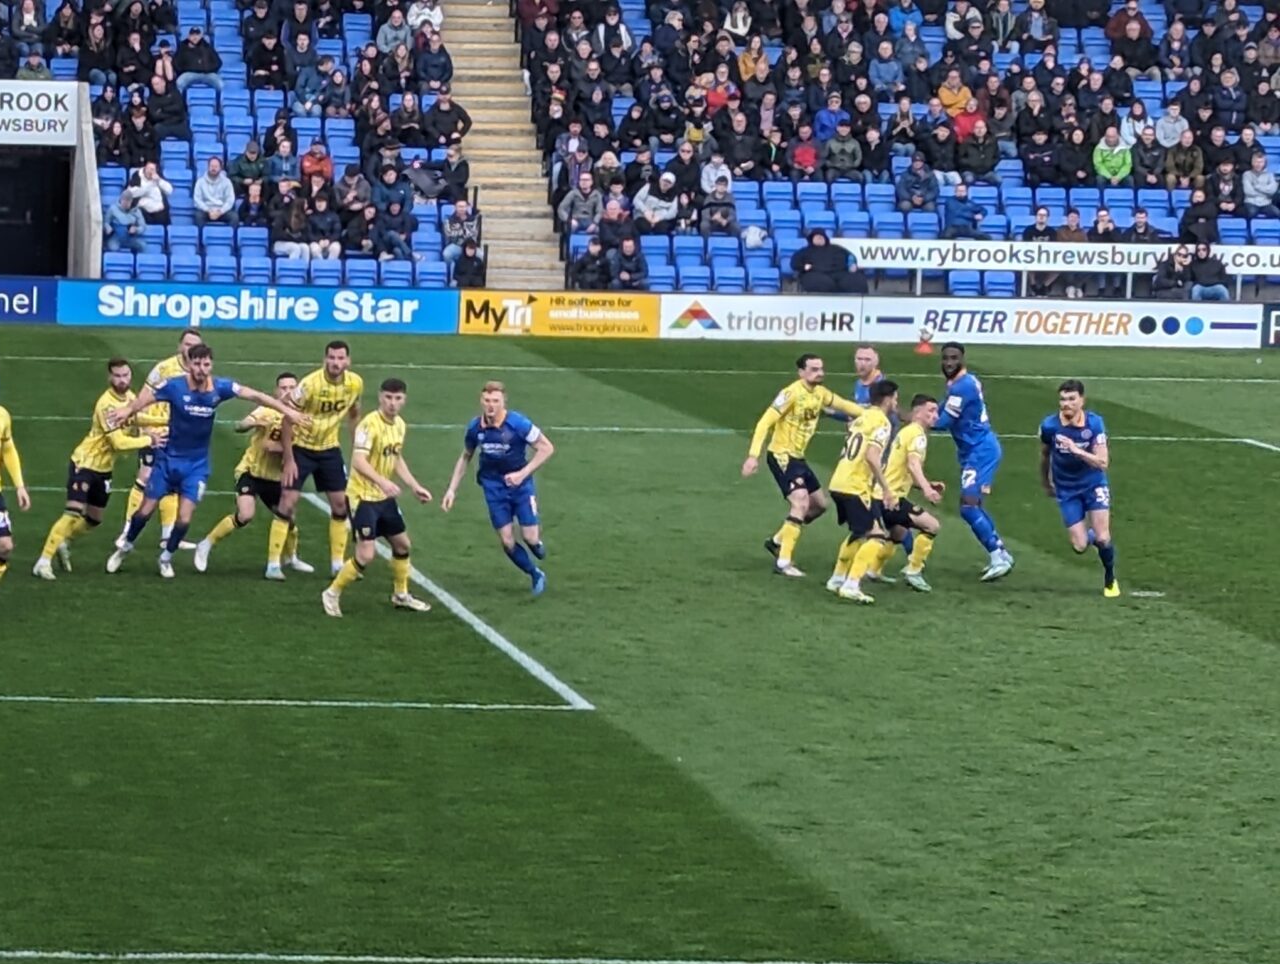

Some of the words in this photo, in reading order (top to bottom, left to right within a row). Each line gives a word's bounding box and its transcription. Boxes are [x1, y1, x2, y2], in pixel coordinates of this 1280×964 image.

[860, 243, 1280, 271] www.rybrookshrewsbury.co.u
[98, 284, 320, 326] Shropshire
[333, 290, 420, 323] Star
[465, 297, 534, 332] MyTri
[568, 297, 615, 307] software
[618, 298, 632, 307] for
[727, 311, 855, 337] triangleHR
[924, 310, 1008, 333] BETTER
[1013, 310, 1132, 336] TOGETHER
[321, 399, 347, 413] BG
